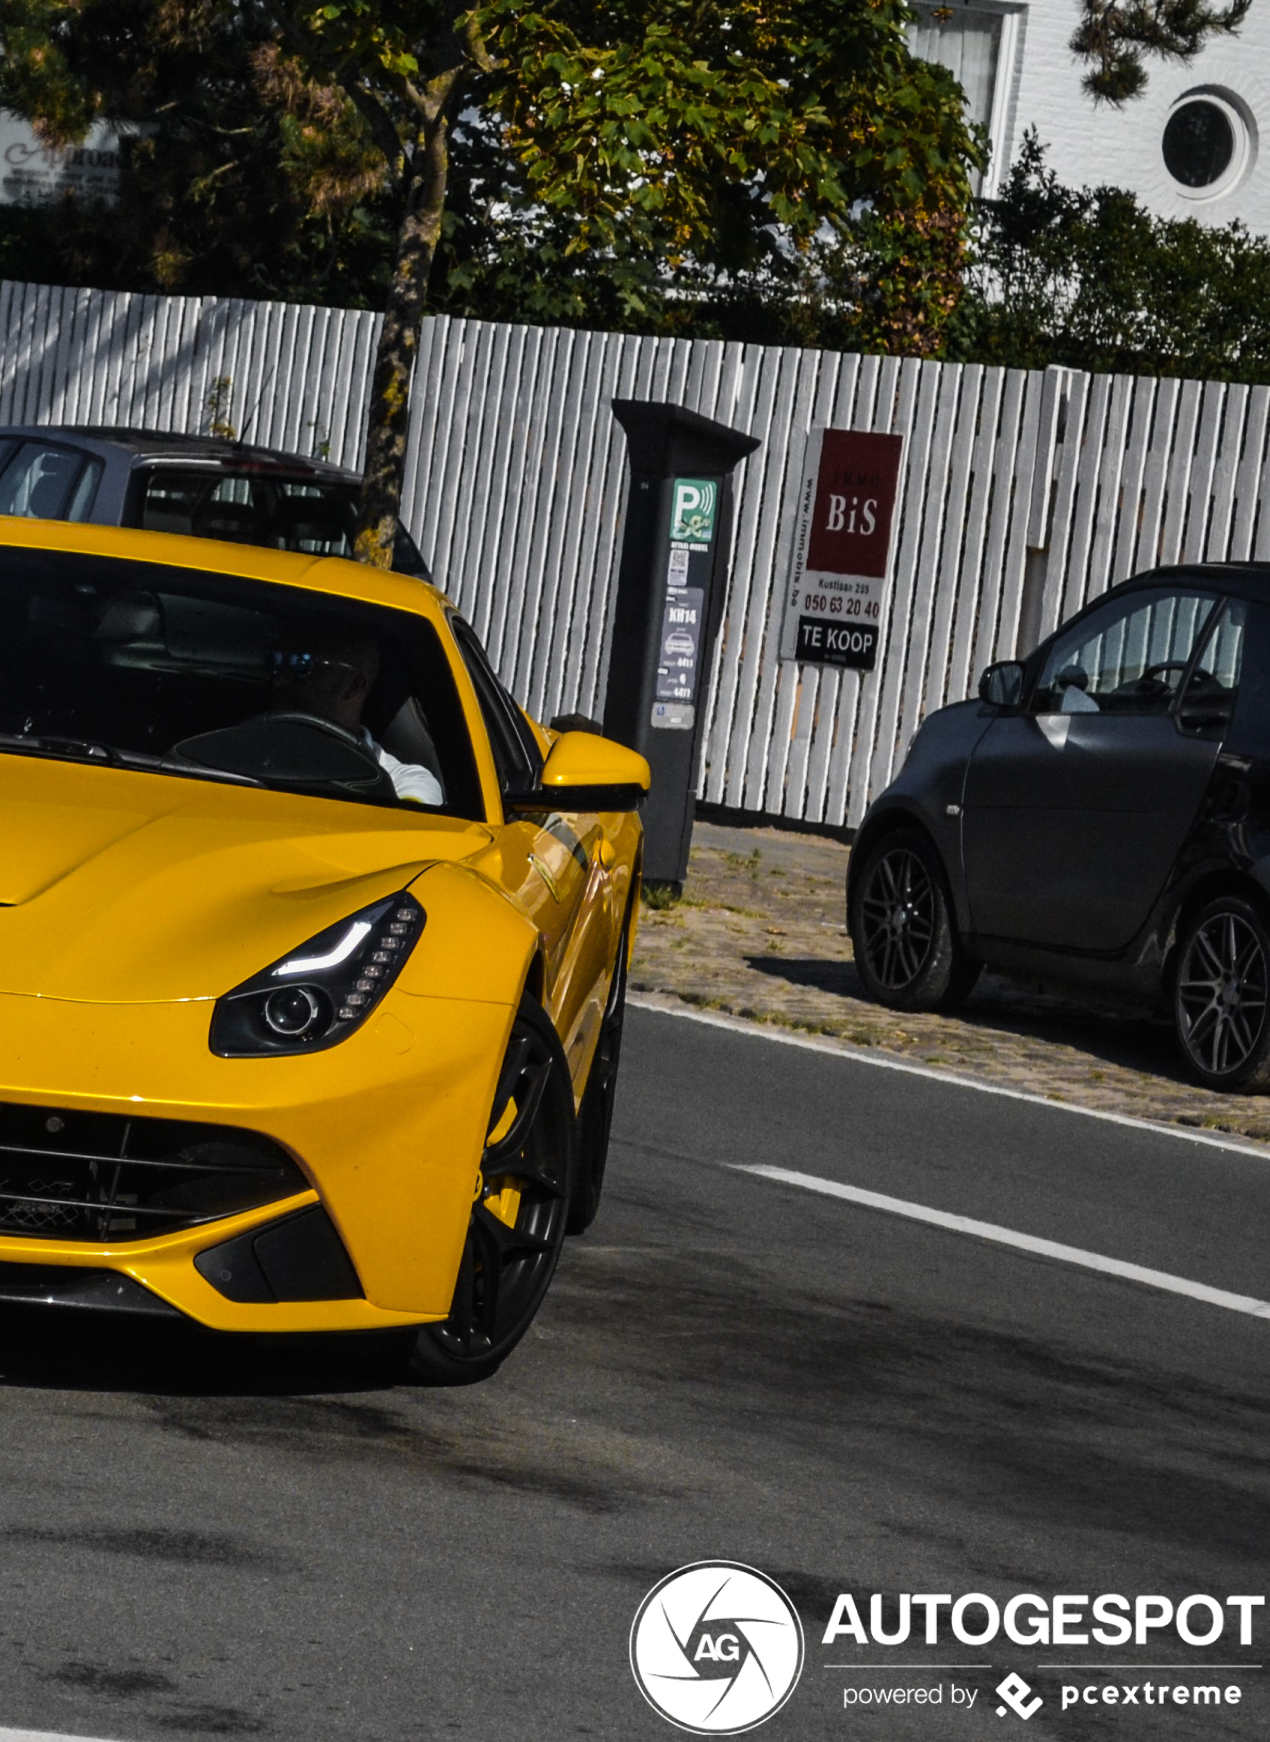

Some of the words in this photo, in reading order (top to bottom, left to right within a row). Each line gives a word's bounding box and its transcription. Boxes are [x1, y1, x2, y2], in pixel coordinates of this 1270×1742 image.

[825, 493, 878, 536] BiS
[804, 594, 827, 612] 050
[830, 596, 843, 614] 63
[845, 598, 861, 616] 20
[864, 601, 880, 618] 40
[802, 624, 823, 648] TE
[826, 627, 873, 654] KOOP
